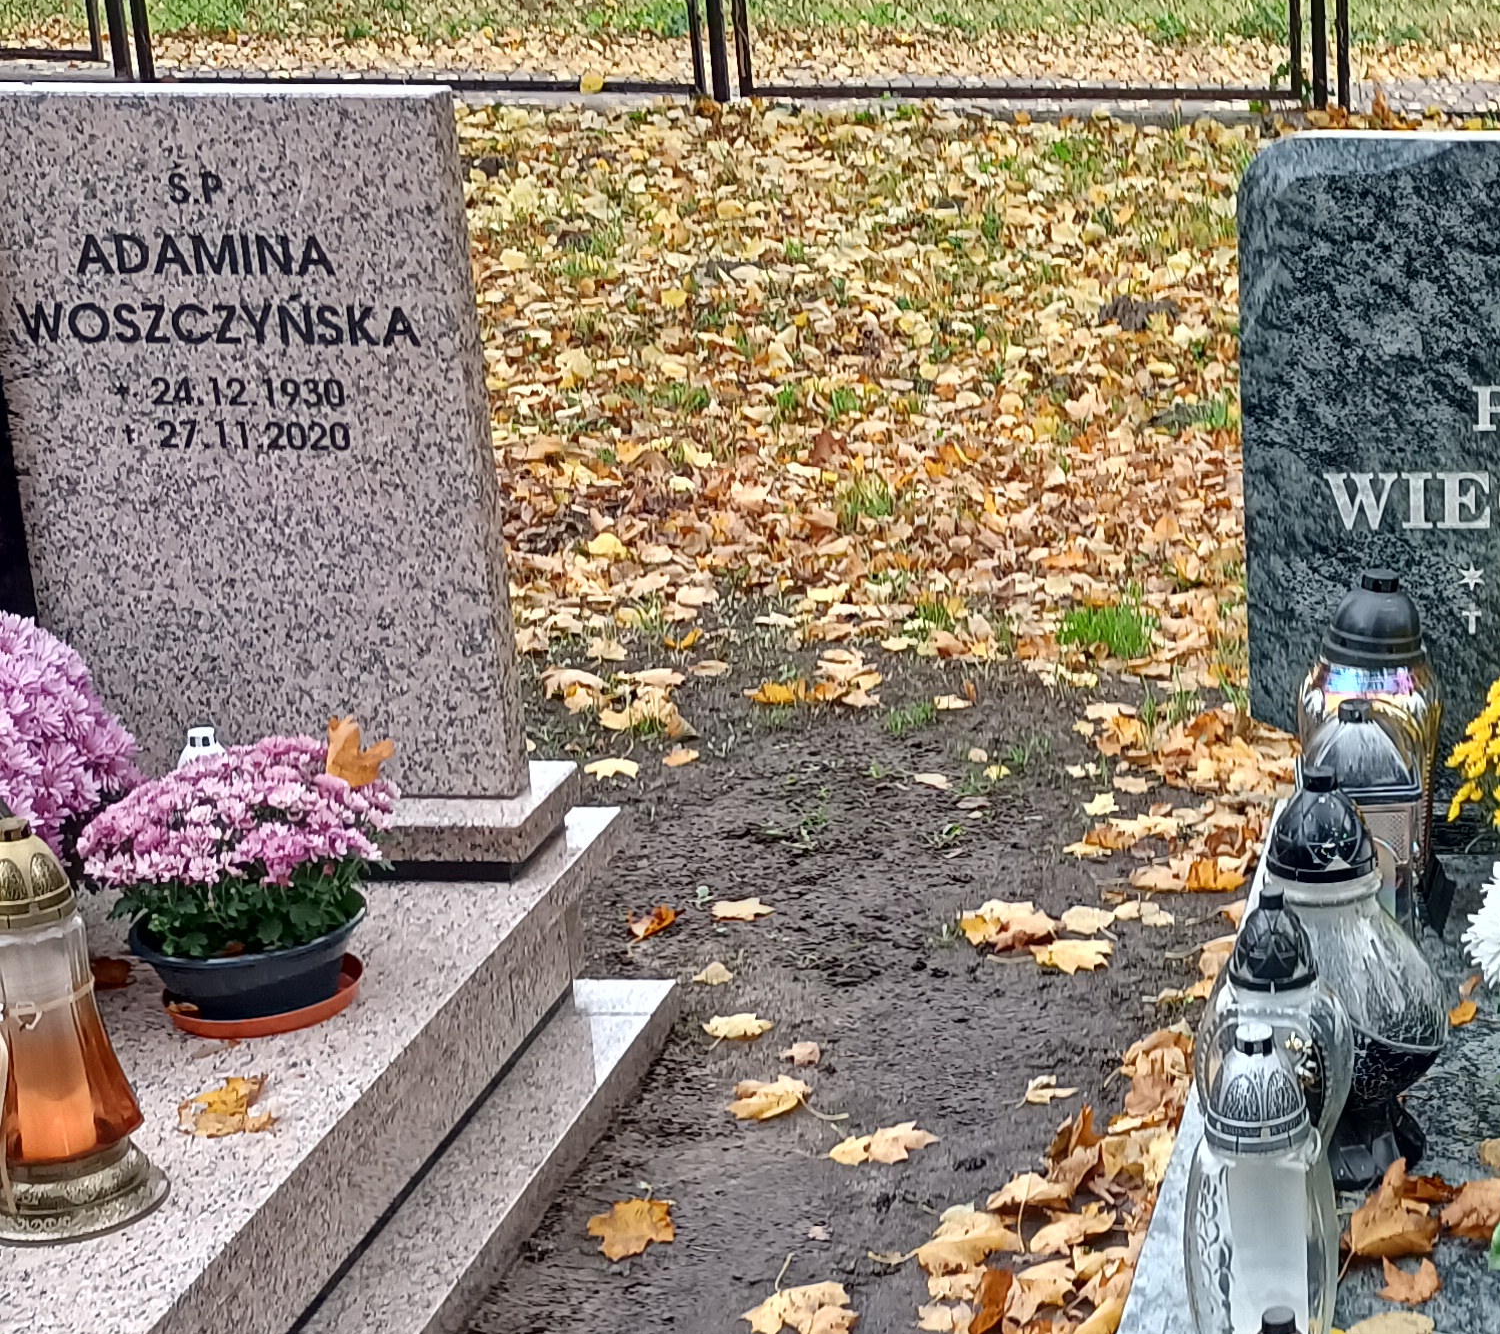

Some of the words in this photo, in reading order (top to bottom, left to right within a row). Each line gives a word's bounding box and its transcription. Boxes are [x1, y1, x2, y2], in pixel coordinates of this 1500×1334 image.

[77, 234, 336, 275] ADAMINA
[16, 295, 421, 347] WOSZCZYŃSKA
[151, 376, 345, 408] 24.12.1930
[157, 419, 350, 451] 27.11.2020
